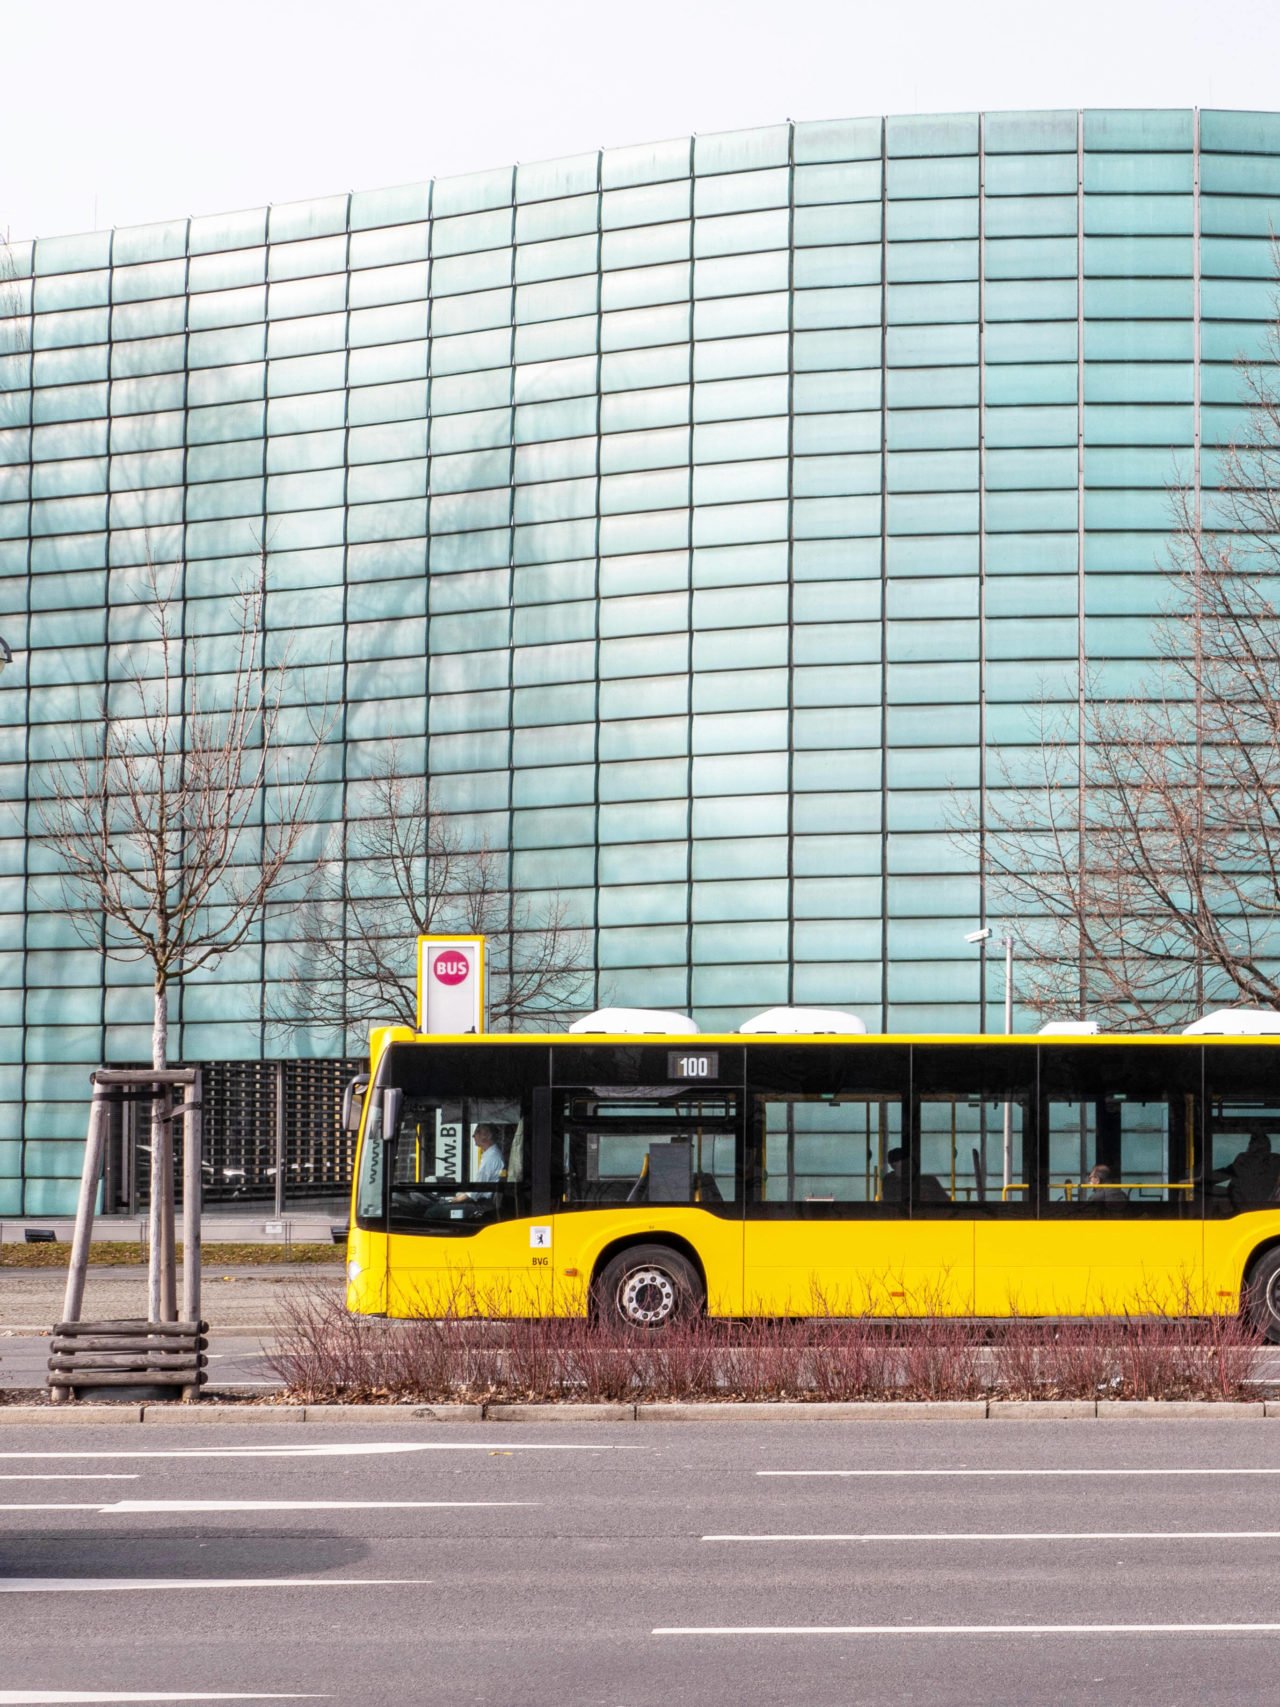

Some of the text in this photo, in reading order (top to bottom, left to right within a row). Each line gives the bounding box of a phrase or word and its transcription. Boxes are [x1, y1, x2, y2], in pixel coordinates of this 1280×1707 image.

[436, 961, 467, 975] BUS
[680, 1057, 708, 1077] 100
[532, 1257, 549, 1266] BVG
